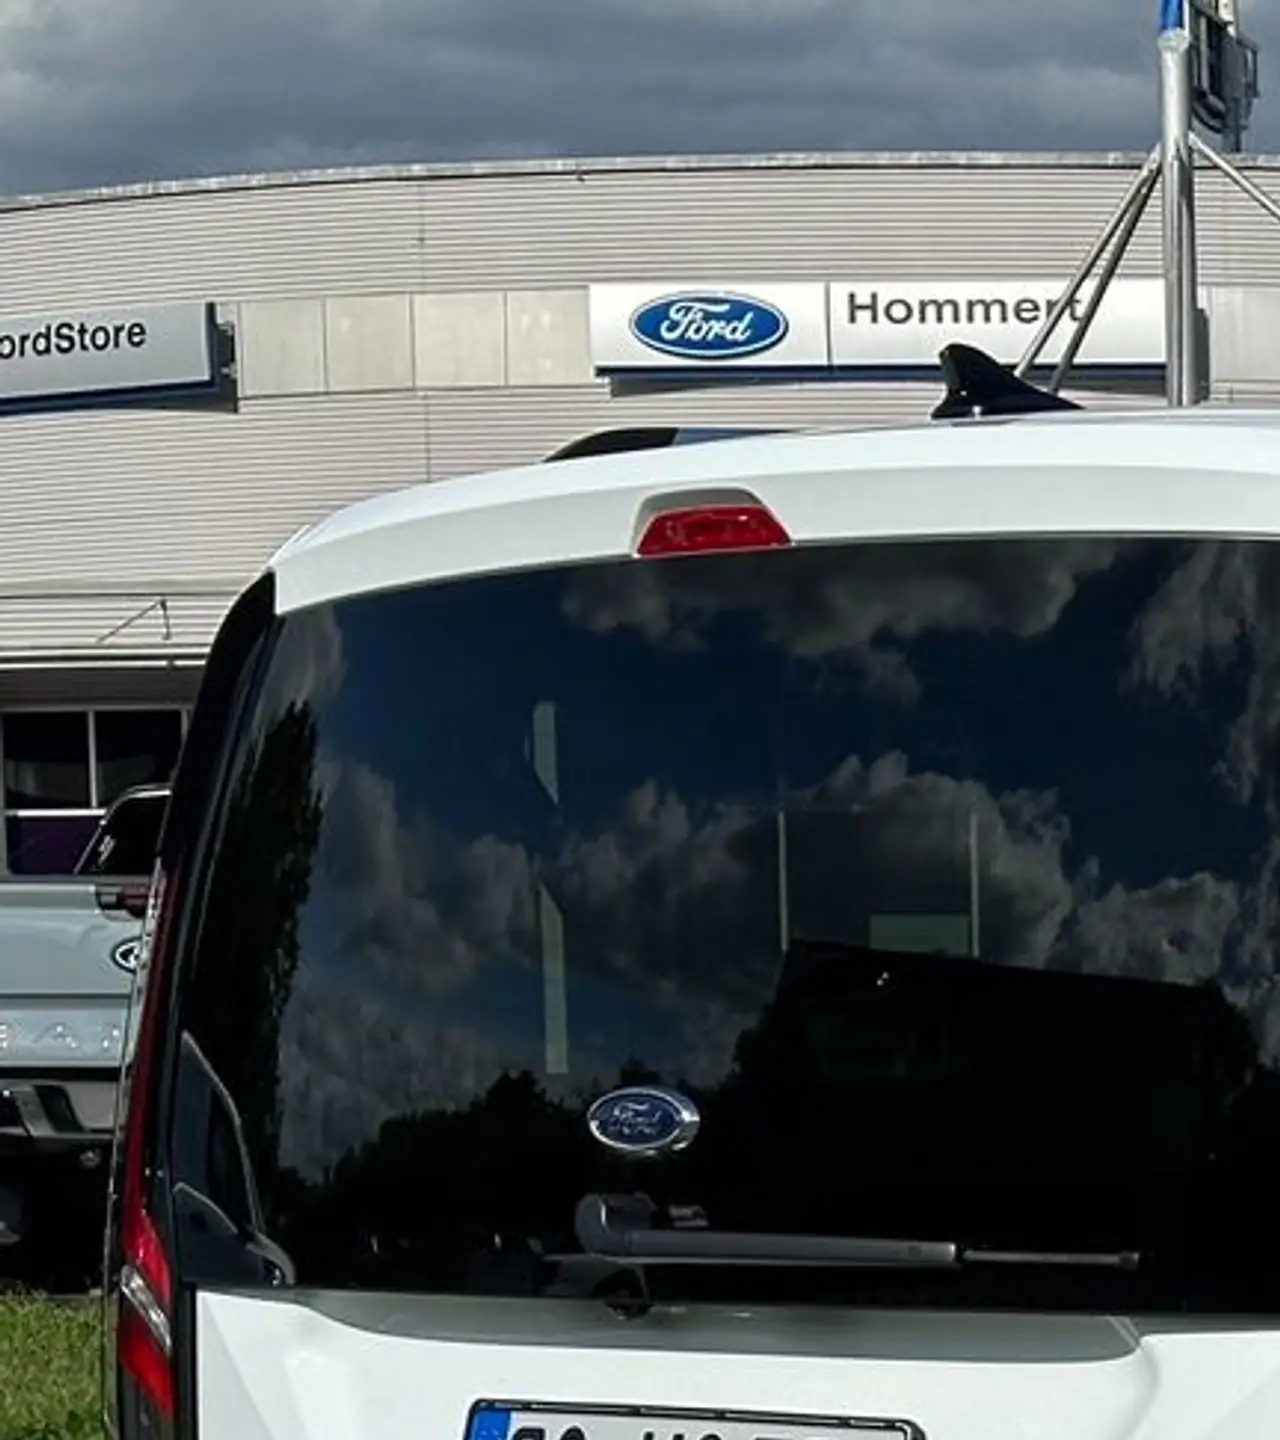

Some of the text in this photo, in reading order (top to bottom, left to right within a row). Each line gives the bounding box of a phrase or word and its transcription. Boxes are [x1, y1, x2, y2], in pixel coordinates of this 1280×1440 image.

[660, 302, 754, 342] Ford
[847, 292, 1083, 325] Hommert
[0, 321, 147, 360] ordStore
